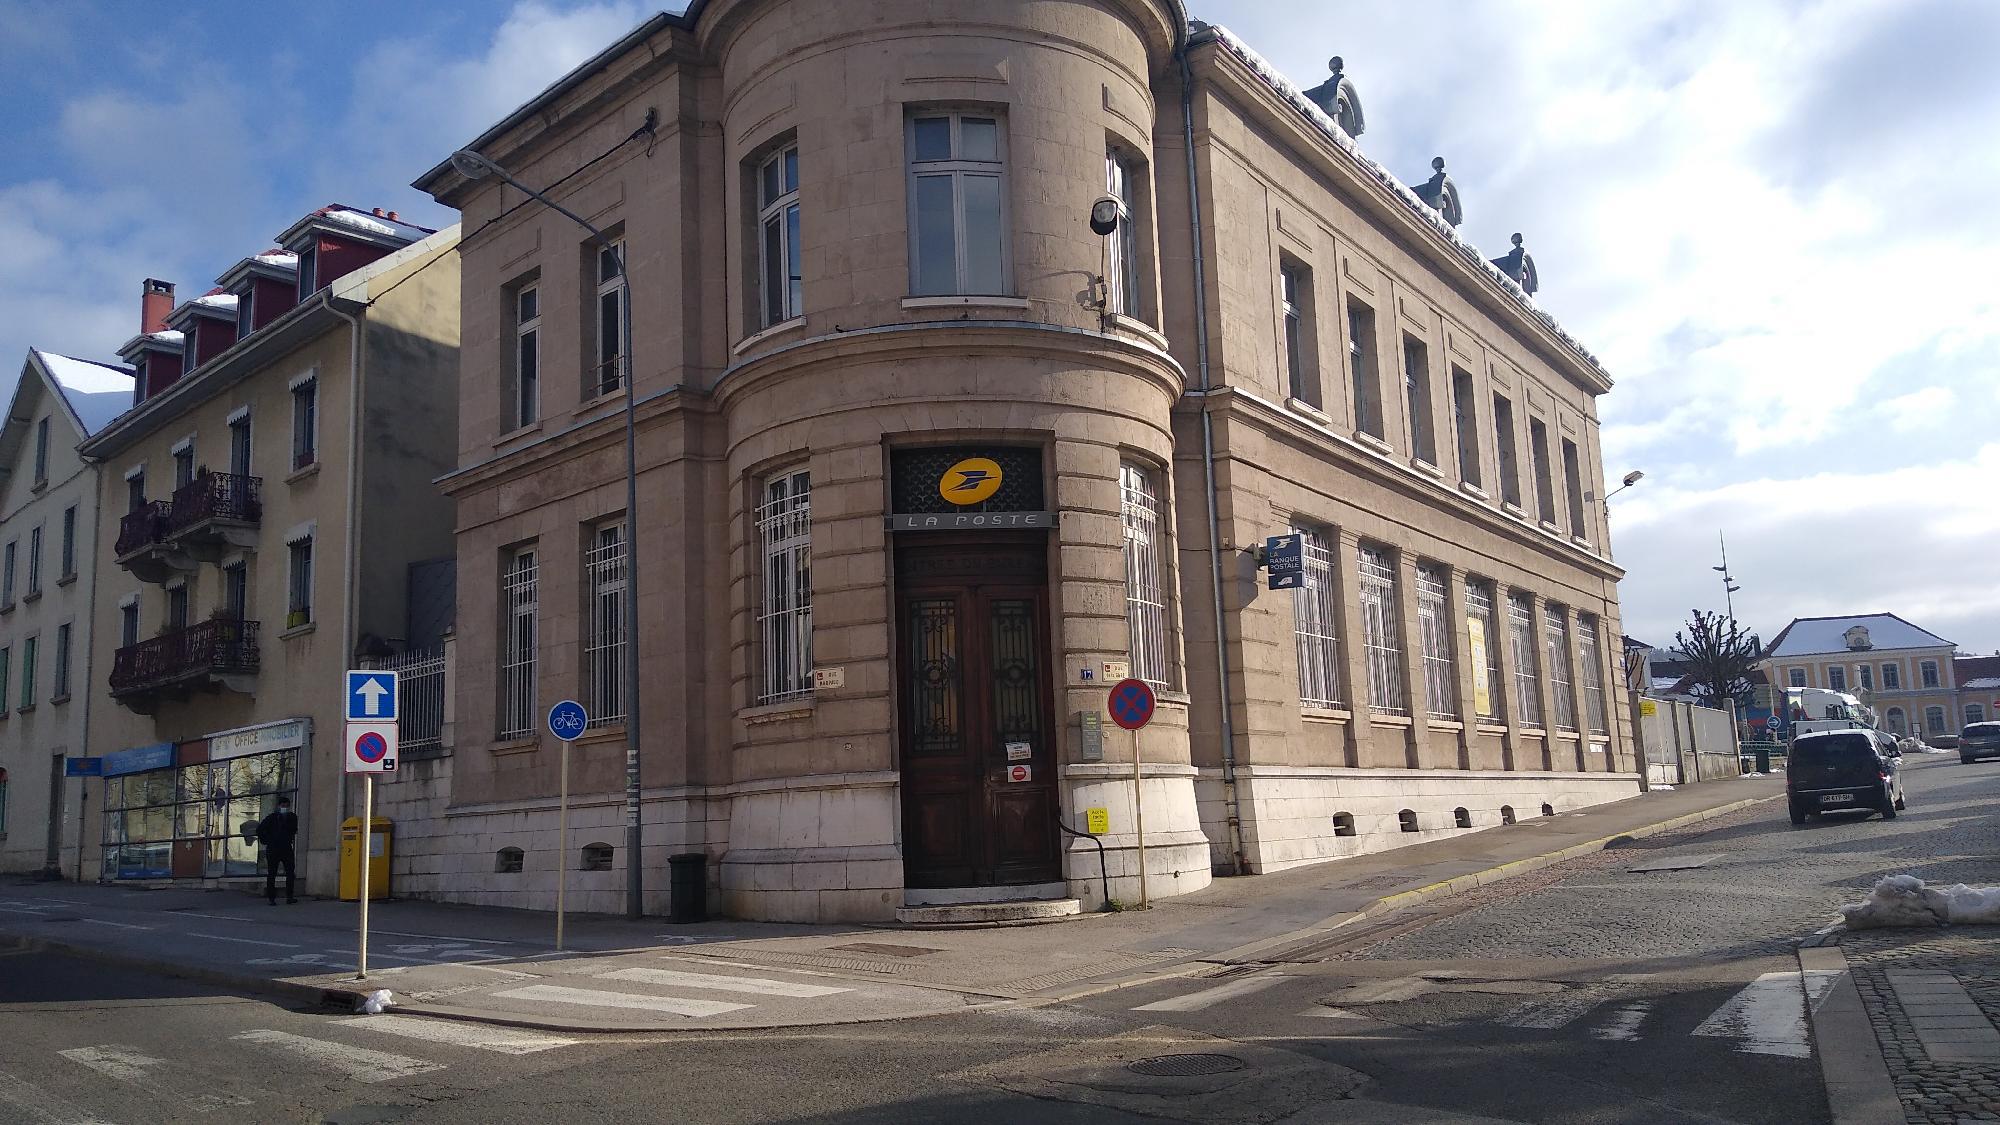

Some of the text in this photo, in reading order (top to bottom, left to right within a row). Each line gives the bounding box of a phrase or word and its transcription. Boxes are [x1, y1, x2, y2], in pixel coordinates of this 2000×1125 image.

[907, 514, 1038, 527] LA POSTE
[1269, 555, 1299, 564] BANQUE
[1270, 562, 1300, 570] POSTALE
[234, 731, 259, 749] OFFICE
